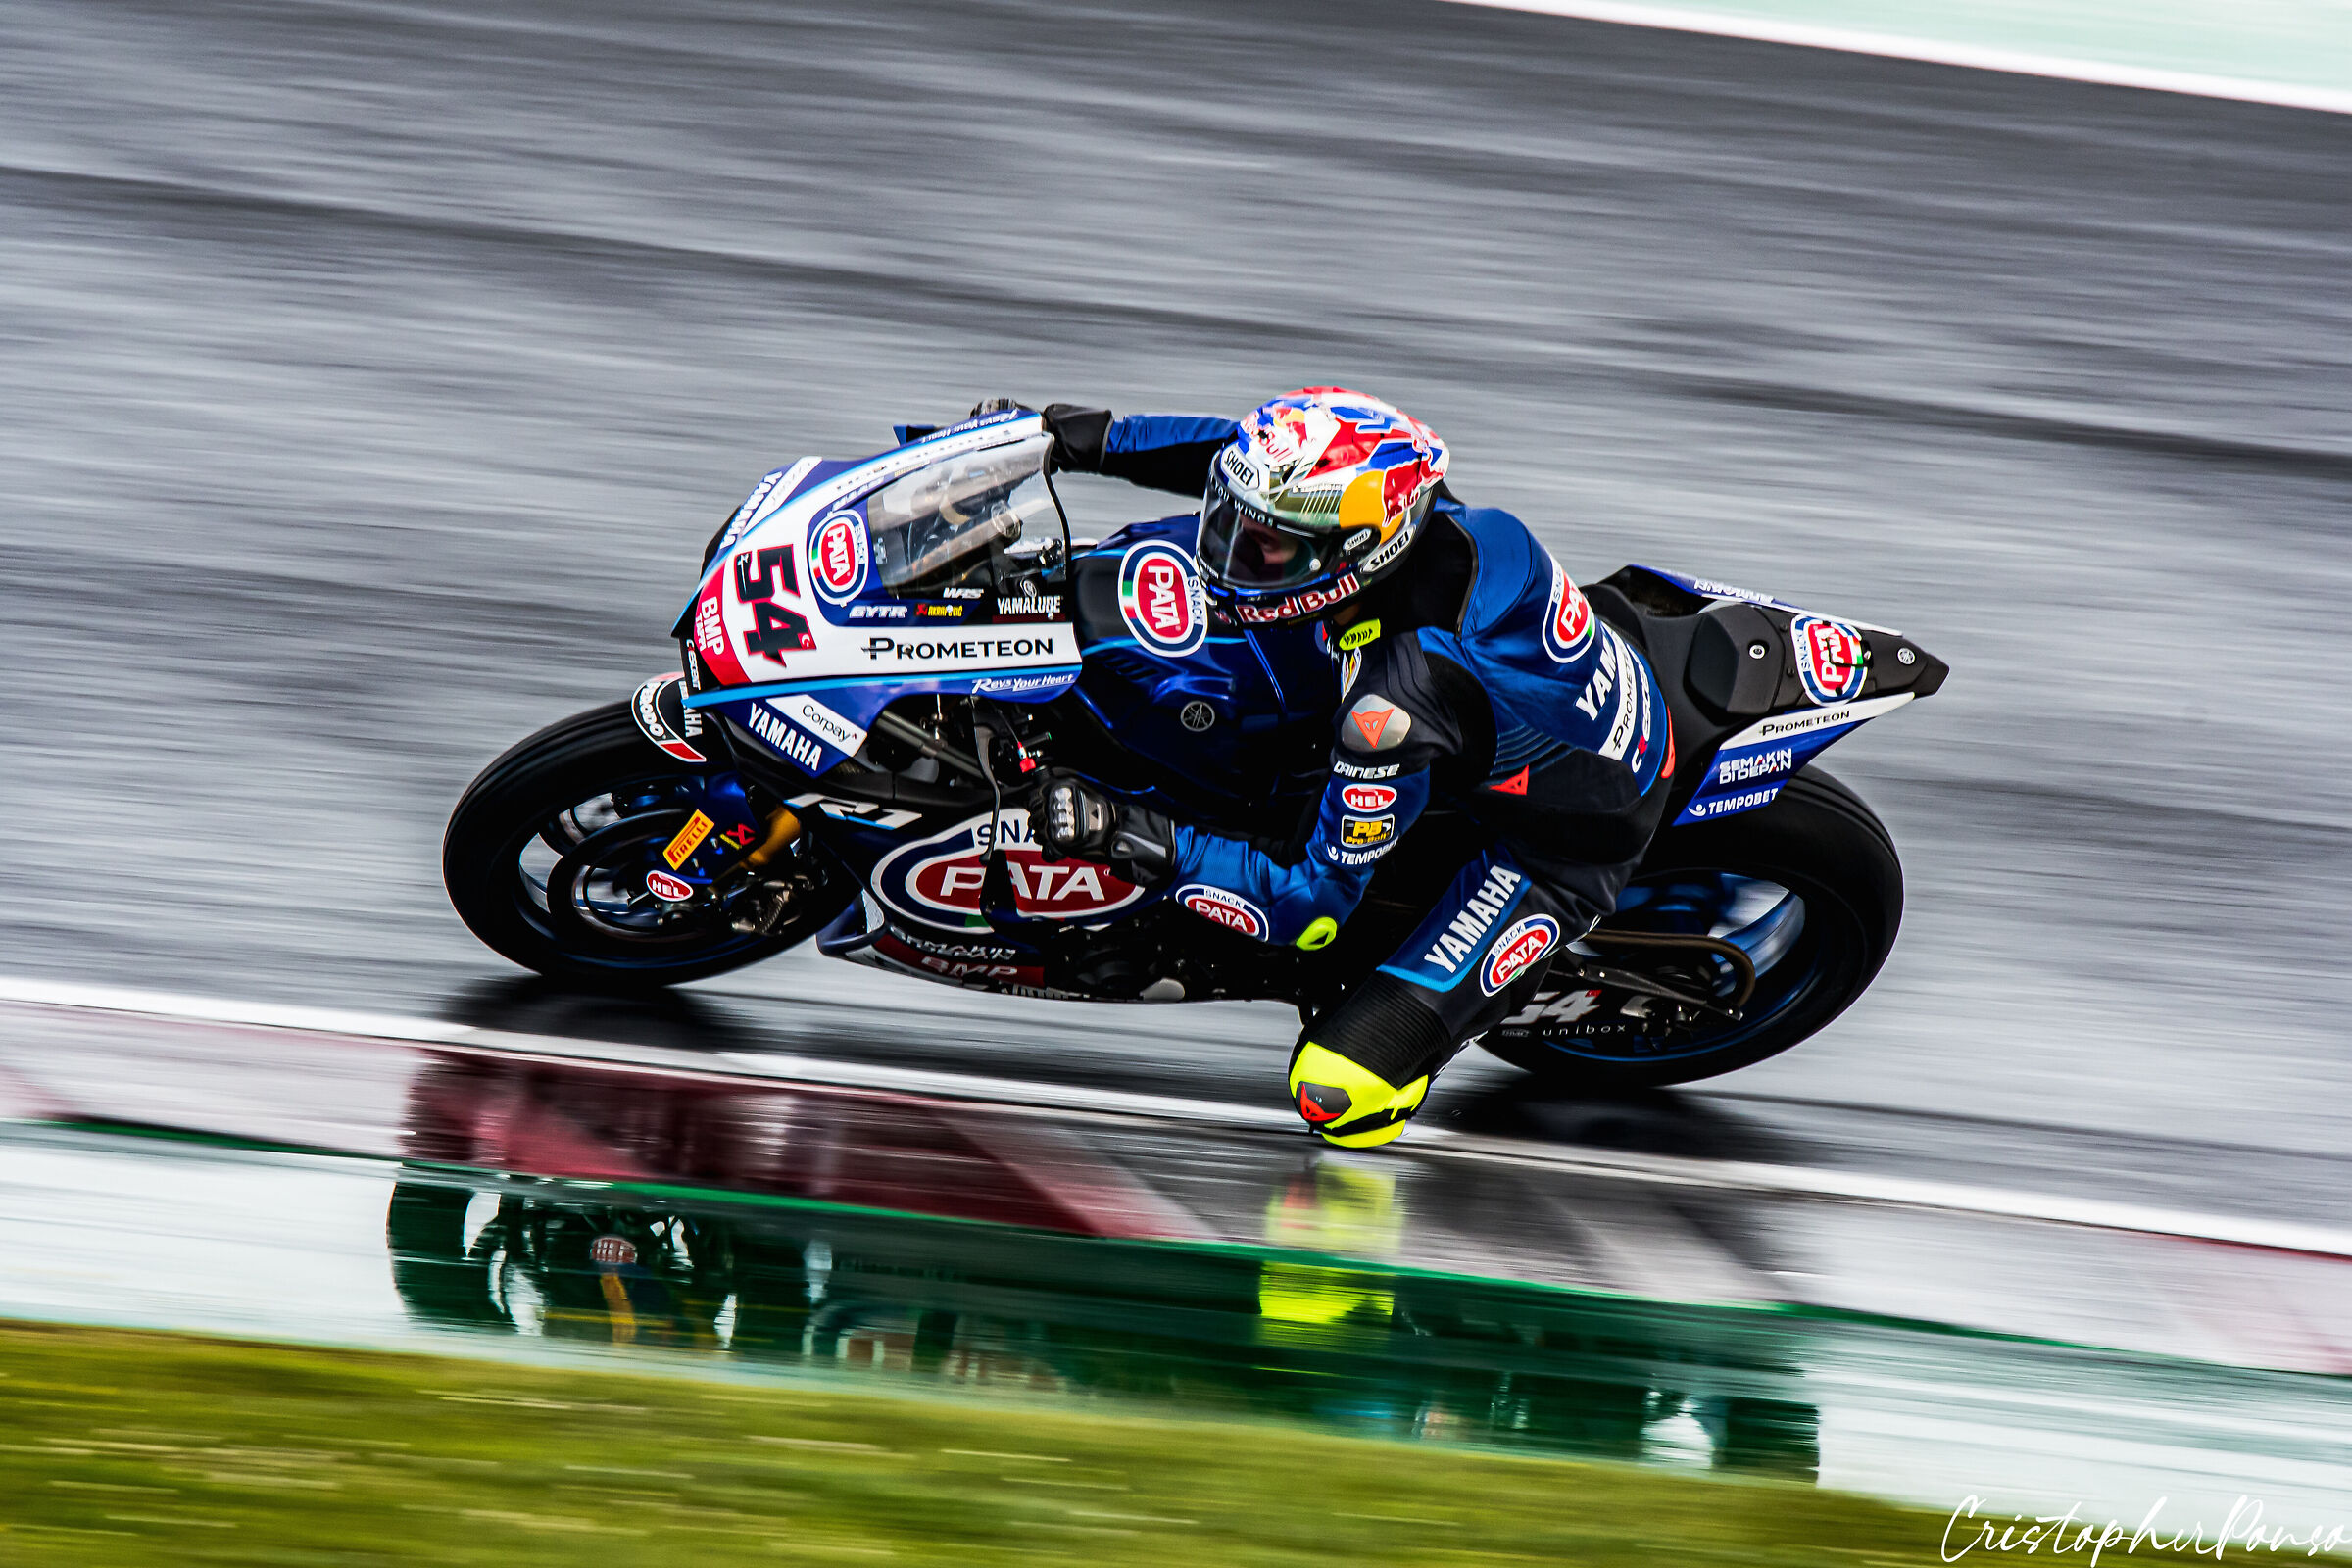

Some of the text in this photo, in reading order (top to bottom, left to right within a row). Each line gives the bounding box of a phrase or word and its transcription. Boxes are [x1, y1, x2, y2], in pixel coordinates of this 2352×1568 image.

[1224, 450, 1254, 487] SHOEI
[827, 524, 851, 581] PATA
[1370, 531, 1410, 566] SHOEI
[734, 543, 817, 668] 54
[1148, 565, 1181, 630] PATA
[1235, 596, 1301, 622] Red
[1298, 572, 1360, 613] Bull
[701, 596, 725, 655] BMP
[972, 674, 1074, 694] Revs Your Heart
[748, 702, 823, 771] YAMAHA
[802, 704, 851, 742] Corpay
[1719, 748, 1792, 774] SEMAKIN
[1350, 793, 1389, 807] HEL
[1709, 788, 1779, 814] TEMPOBET
[667, 816, 708, 863] PIRELLI
[1353, 821, 1383, 837] PB
[652, 879, 685, 898] HEL
[1205, 889, 1244, 909] SNACK
[1196, 900, 1248, 932] PATA
[1424, 864, 1521, 974] YAMAHA
[1492, 922, 1526, 956] SNACK
[1496, 936, 1544, 980] PATA
[1543, 1025, 1627, 1037] unibox
